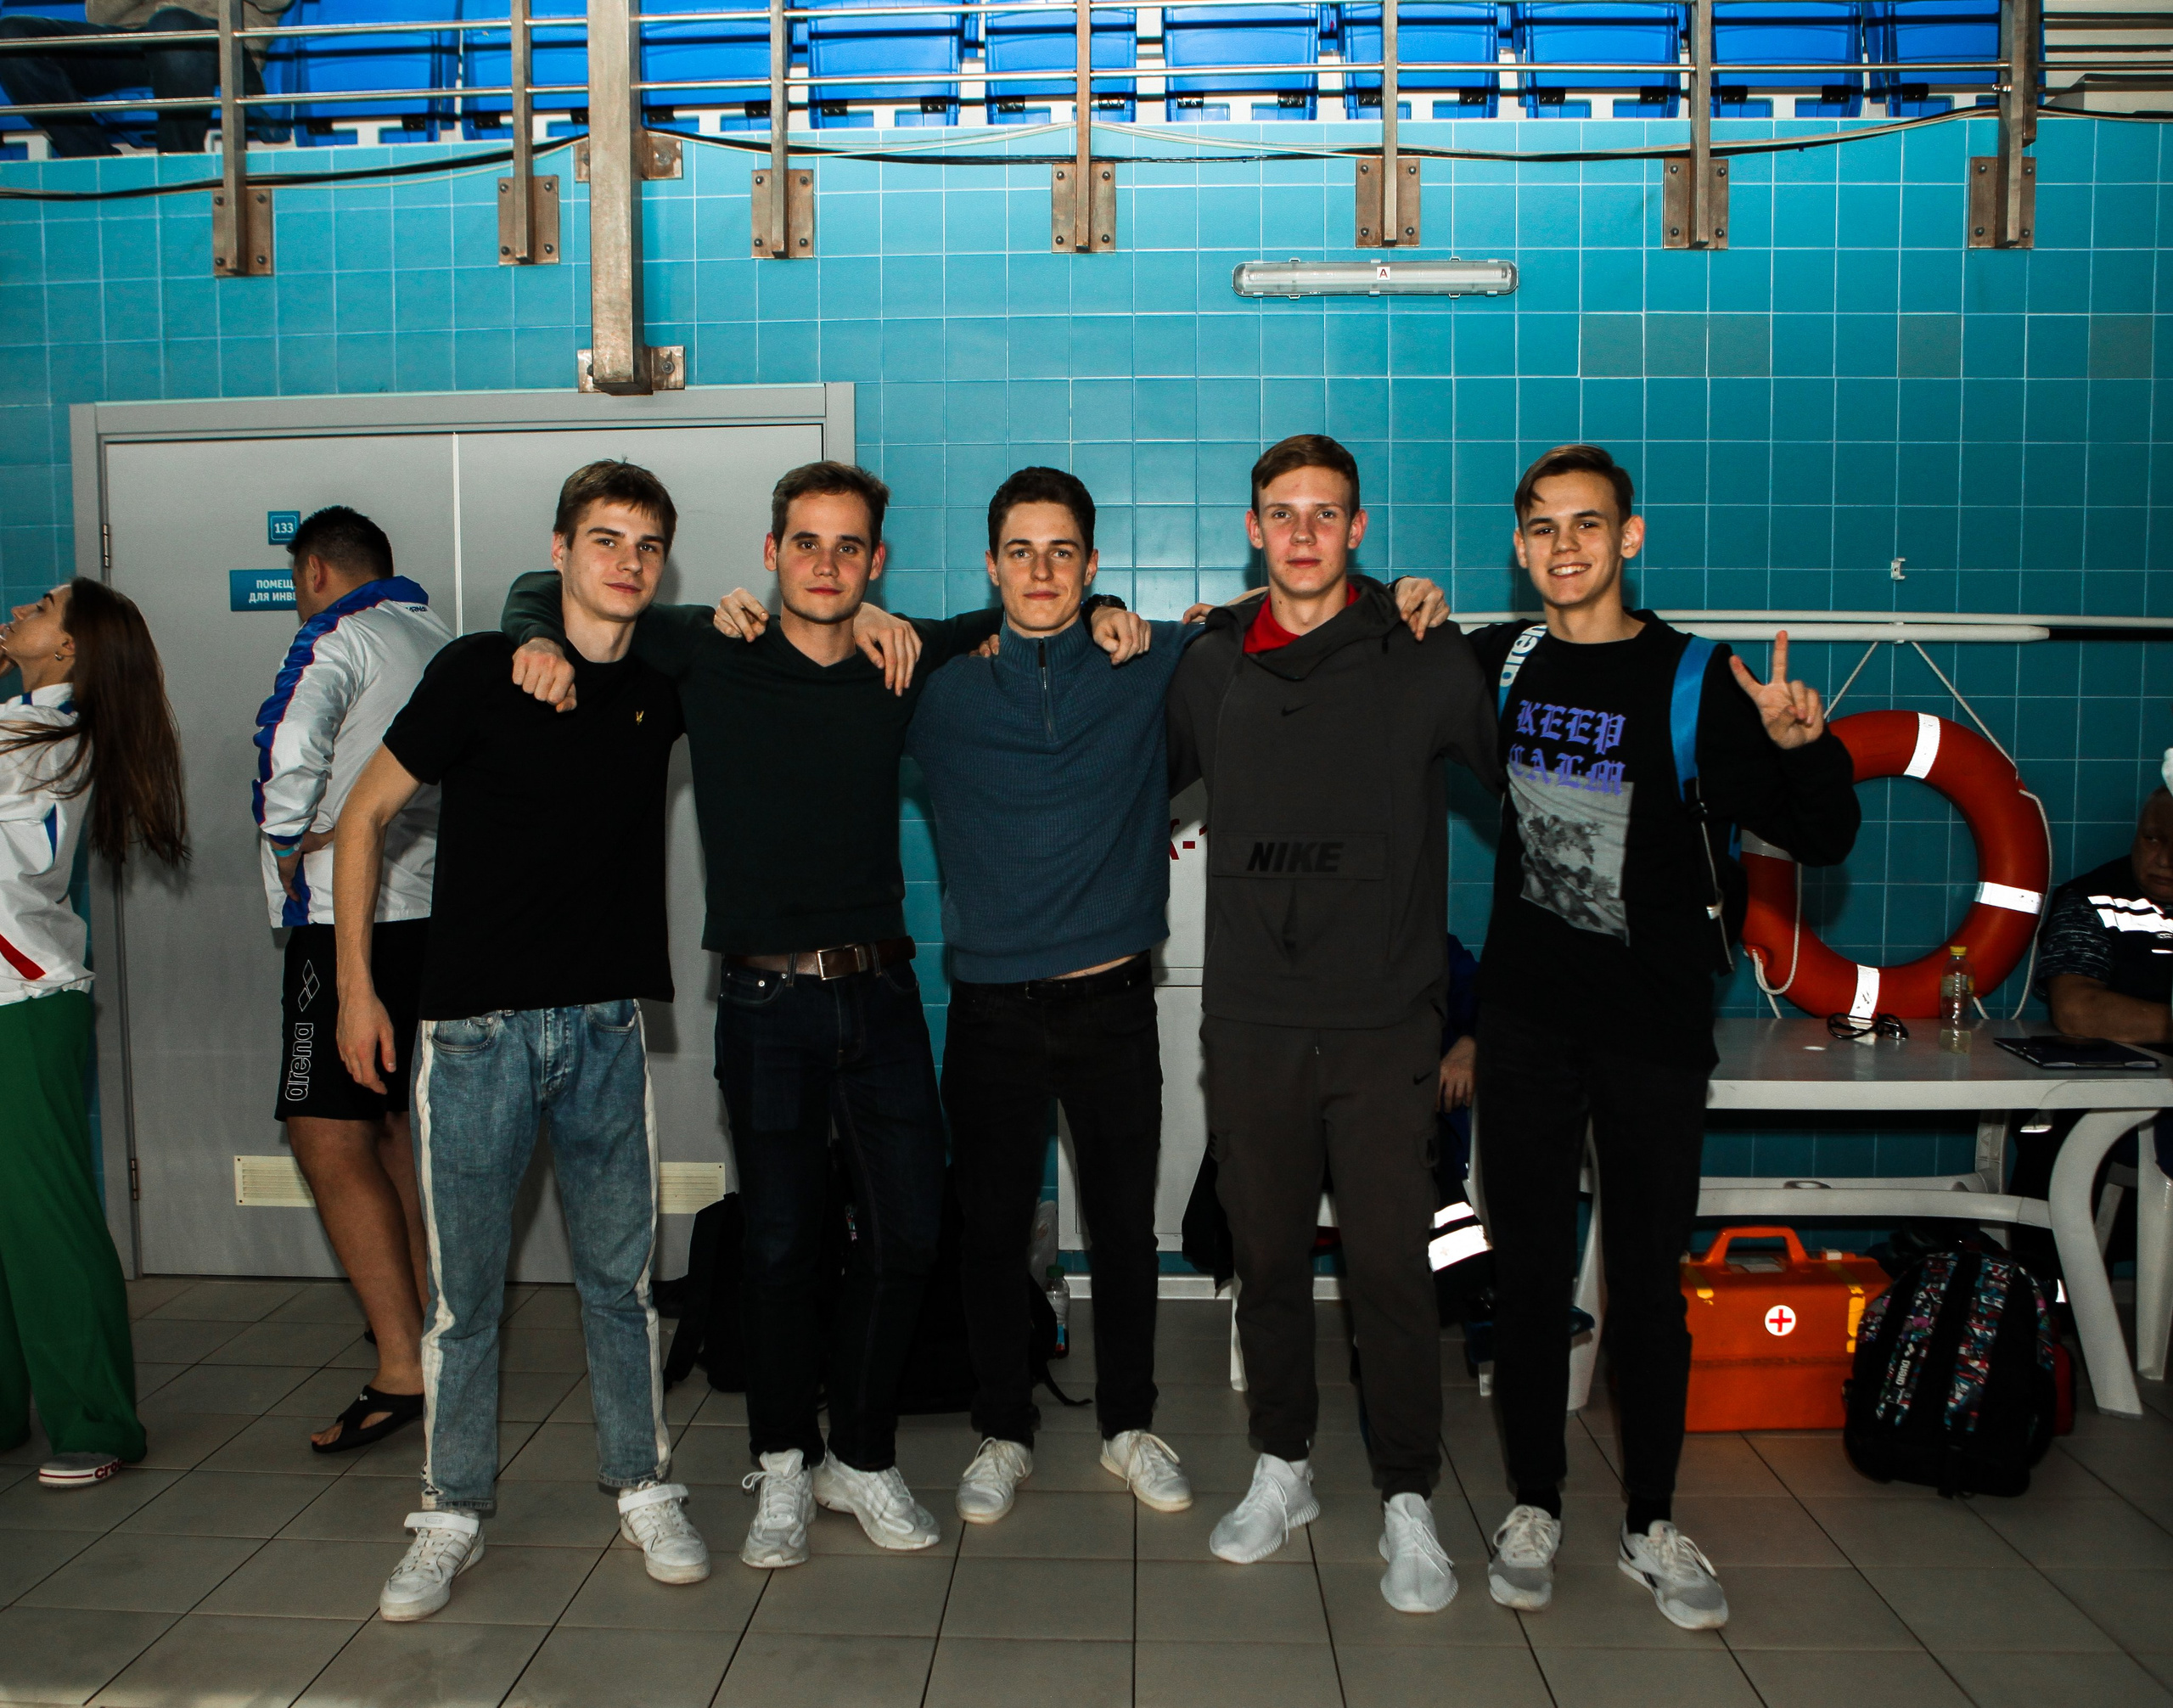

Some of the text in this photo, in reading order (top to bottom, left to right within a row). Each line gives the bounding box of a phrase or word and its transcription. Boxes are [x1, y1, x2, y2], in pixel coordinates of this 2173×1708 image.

[274, 522, 294, 534] 133
[249, 592, 270, 604] ДЛЯ
[1516, 699, 1626, 755] KEEP
[1508, 743, 1626, 796] CALM
[1246, 842, 1345, 873] NIKE
[285, 1022, 314, 1102] arena
[1895, 1359, 1911, 1385] arena
